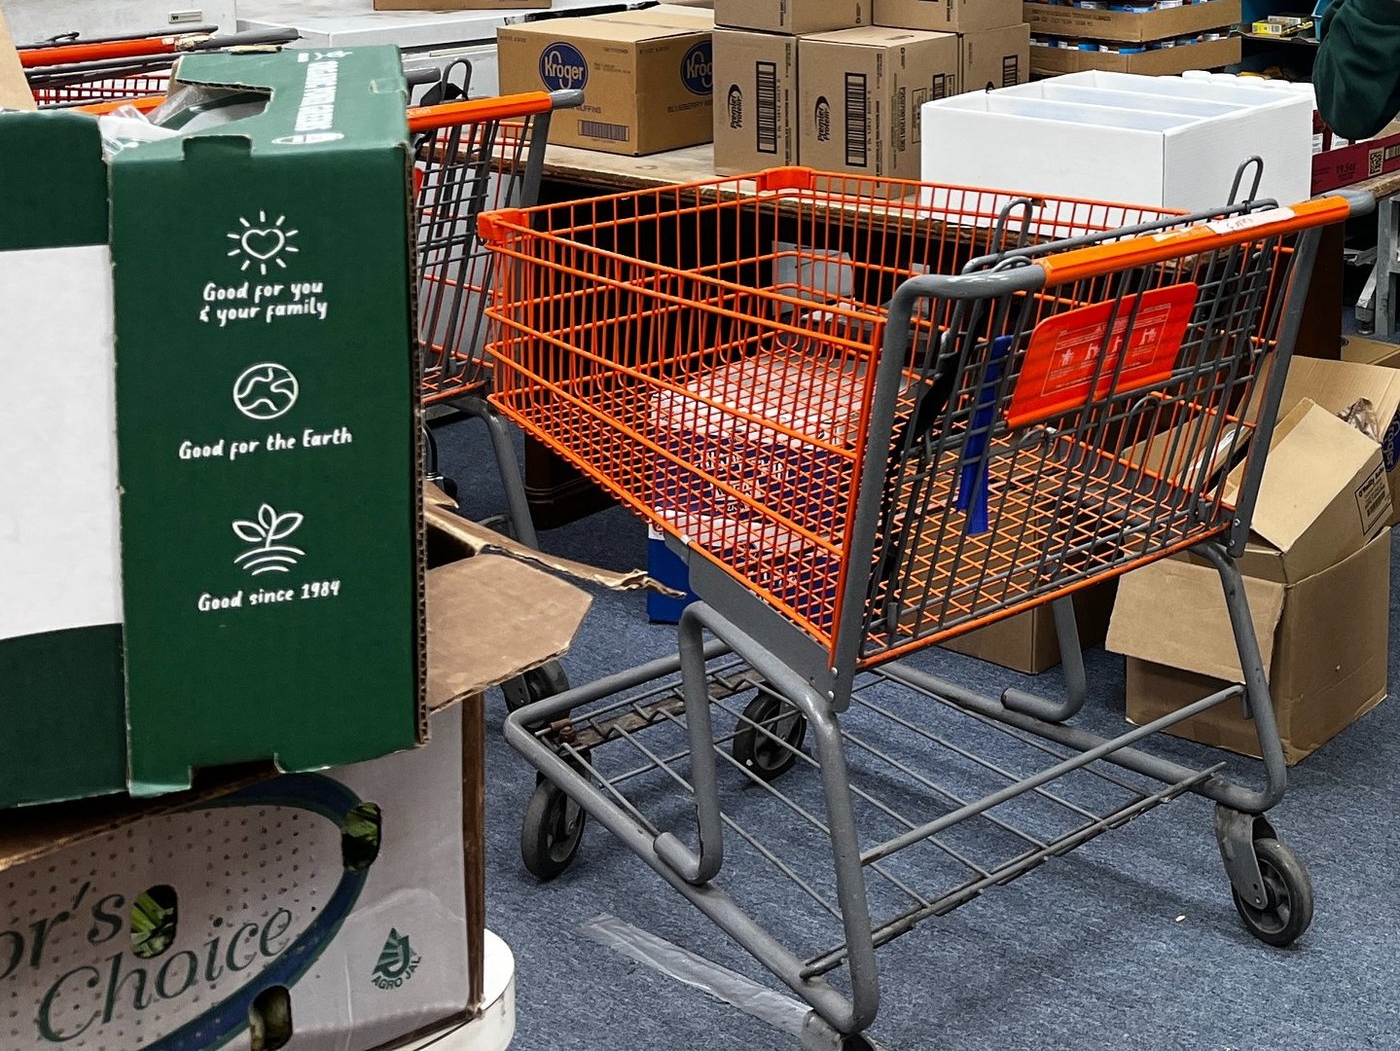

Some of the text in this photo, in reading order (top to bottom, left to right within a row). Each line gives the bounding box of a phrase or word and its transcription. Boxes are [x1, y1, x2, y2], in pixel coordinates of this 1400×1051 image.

[544, 50, 585, 90] Kroger
[686, 50, 712, 88] Krog
[668, 102, 704, 114] BLUEBERRY
[730, 95, 738, 129] Premier
[817, 107, 825, 142] Premier
[203, 282, 324, 303] Good for you
[199, 297, 328, 327] & your family
[178, 427, 353, 460] Good for the Earth
[198, 579, 341, 611] Good since 1984
[0, 882, 125, 980] or's
[37, 908, 293, 1043] Choice
[371, 955, 422, 990] AGRO JAL
